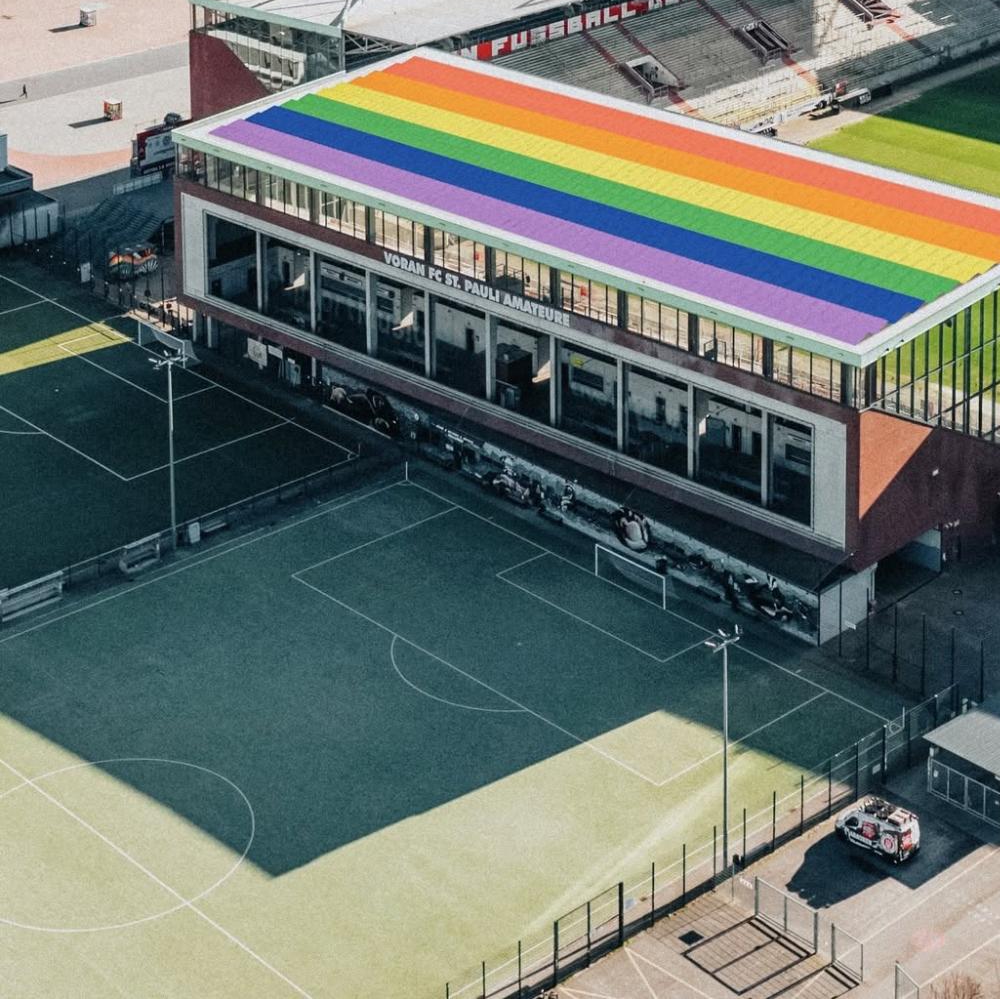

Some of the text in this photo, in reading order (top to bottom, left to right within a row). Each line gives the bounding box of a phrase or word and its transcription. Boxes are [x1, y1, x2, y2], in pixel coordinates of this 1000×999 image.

[491, 2, 636, 57] FUSSBALL
[384, 252, 570, 328] VORAN FC ST. PAULI AMATEURE
